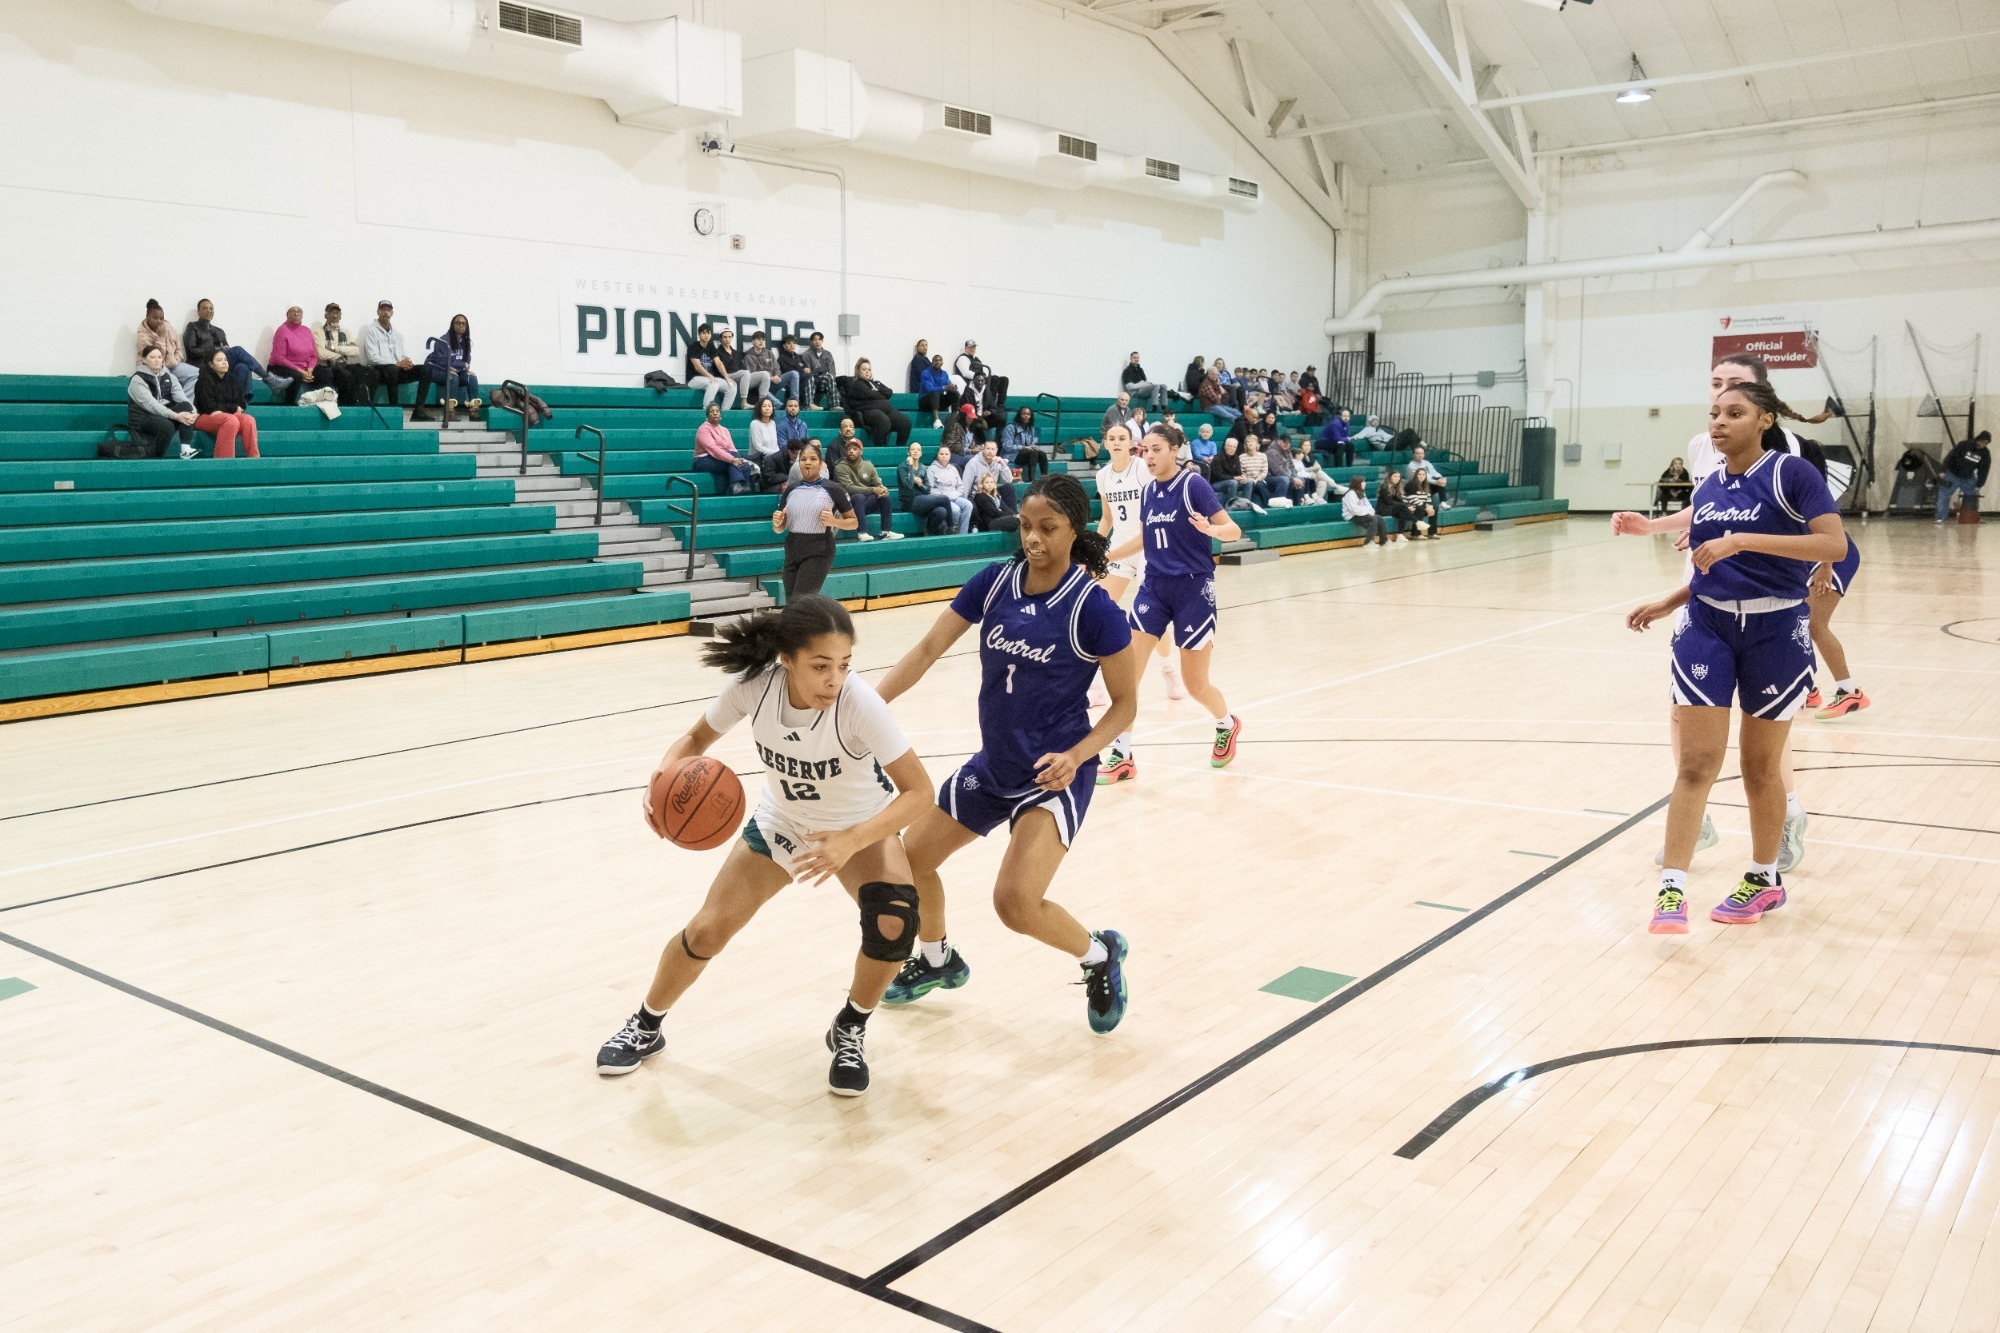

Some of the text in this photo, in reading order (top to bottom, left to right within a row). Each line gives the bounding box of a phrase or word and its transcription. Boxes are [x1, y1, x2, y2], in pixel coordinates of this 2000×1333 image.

[574, 278, 818, 309] WESTERN RESERVE ACADEMY
[1746, 340, 1783, 351] Official
[1763, 352, 1807, 362] Provider
[1118, 505, 1127, 521] 3
[1693, 501, 1762, 525] Central
[1154, 528, 1168, 549] 11
[986, 624, 1056, 664] Central
[1005, 664, 1017, 694] 1
[780, 779, 821, 801] 12
